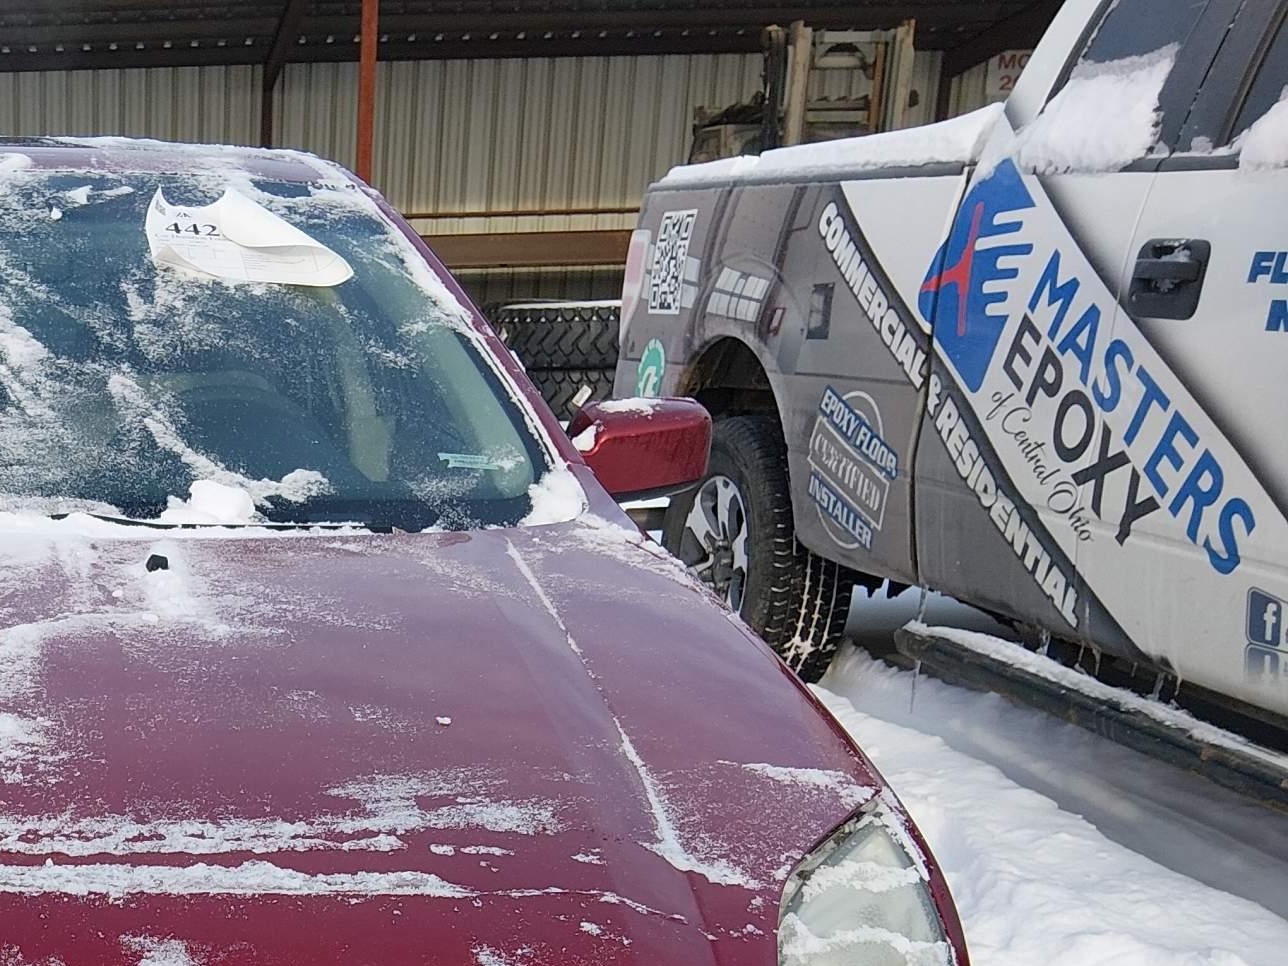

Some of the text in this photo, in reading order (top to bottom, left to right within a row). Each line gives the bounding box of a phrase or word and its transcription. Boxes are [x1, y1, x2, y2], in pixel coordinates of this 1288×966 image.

[999, 75, 1019, 91] 2
[819, 202, 1079, 630] COMMERCIAL & RESIDENTIAL
[821, 389, 897, 478] EPOXY FLOOR
[986, 392, 1095, 542] of Central Ohio
[1002, 312, 1161, 546] EPOXY
[1028, 249, 1256, 575] MASTERS
[809, 475, 872, 549] INSTALLER
[814, 433, 881, 511] CERTIFIED
